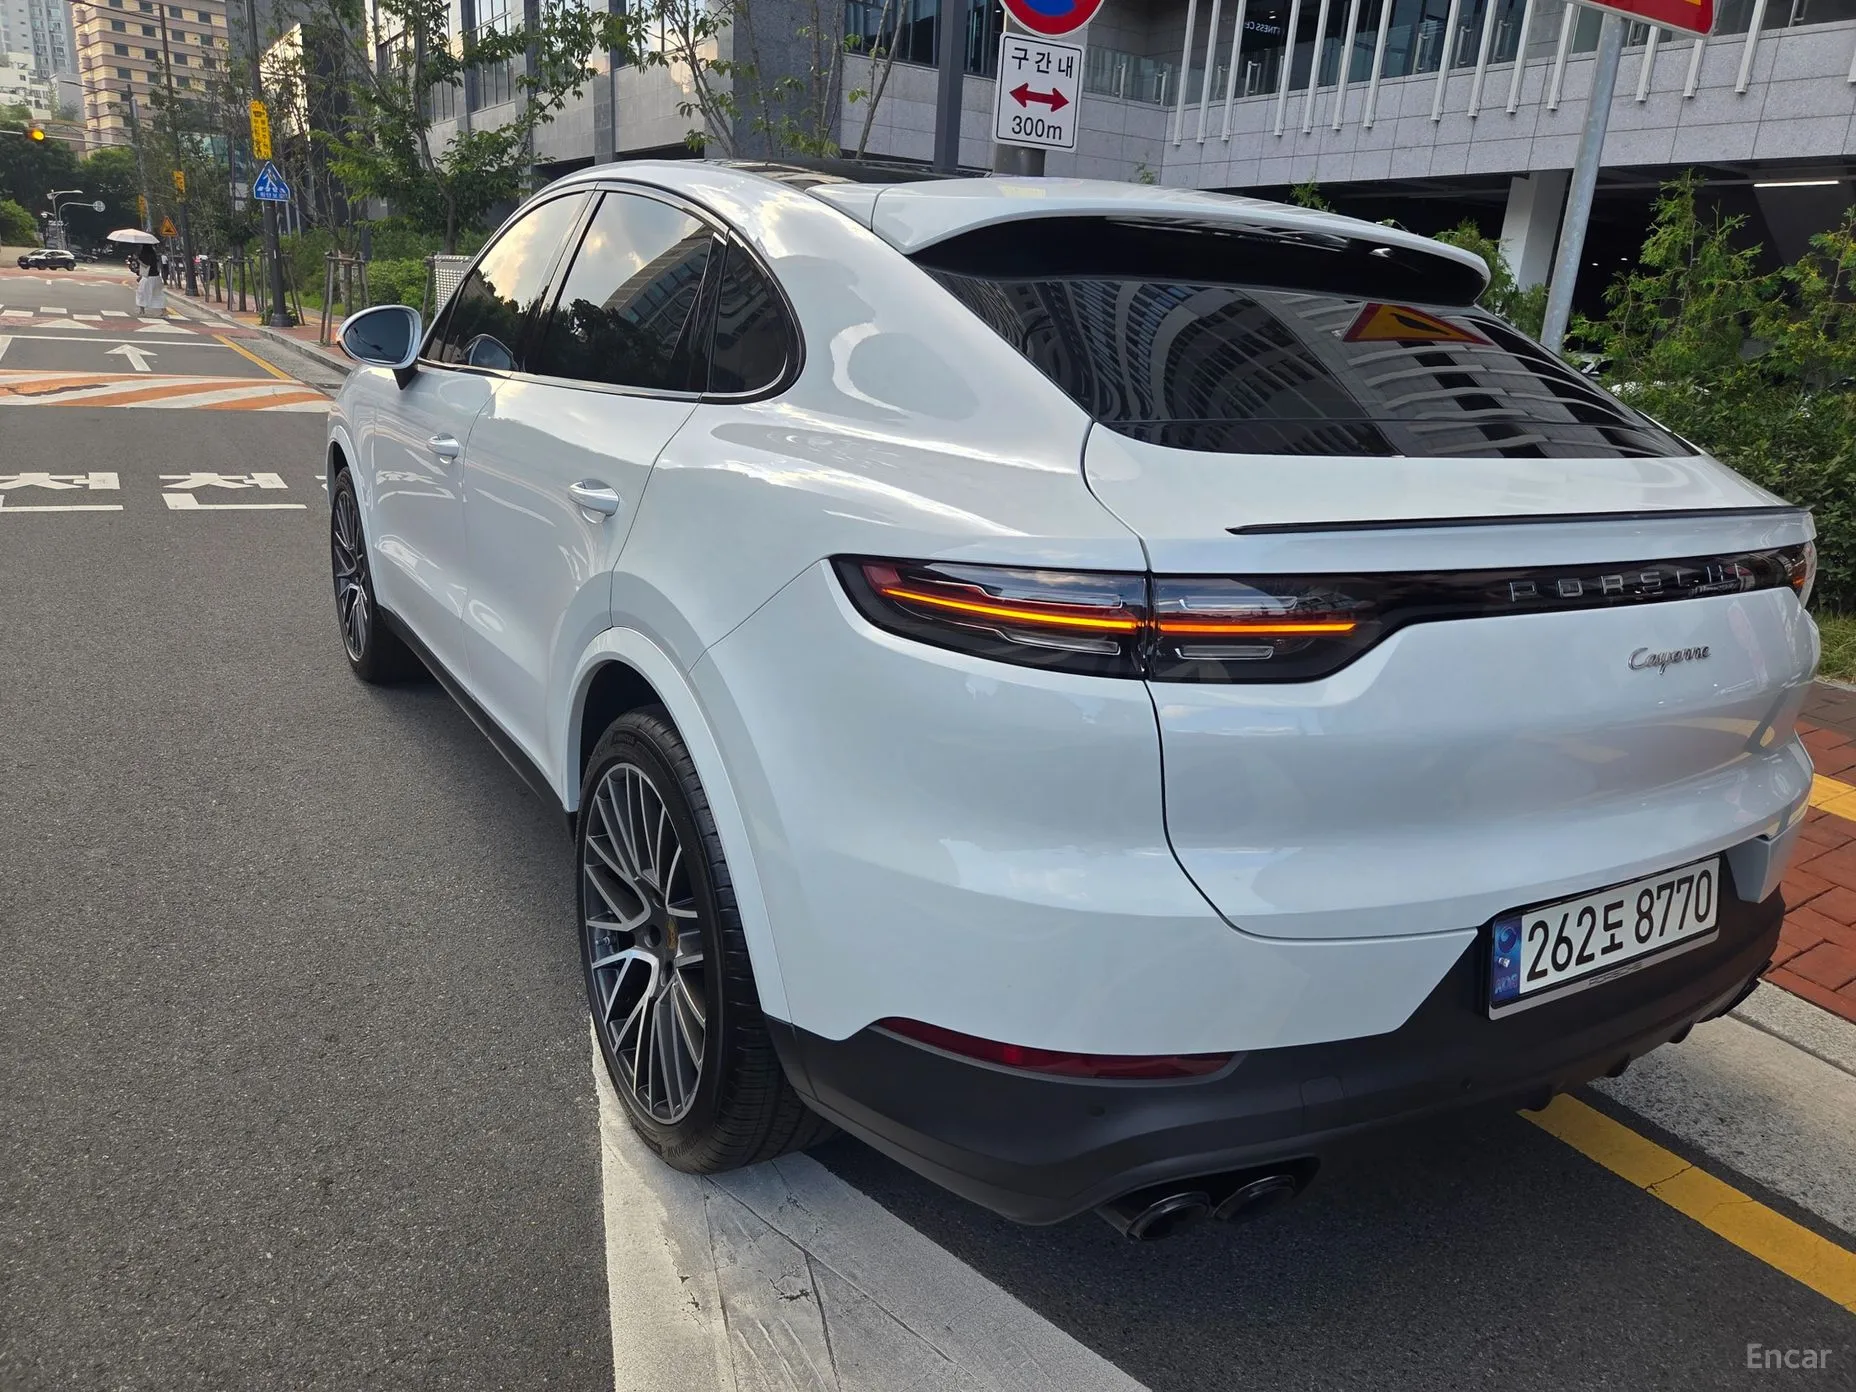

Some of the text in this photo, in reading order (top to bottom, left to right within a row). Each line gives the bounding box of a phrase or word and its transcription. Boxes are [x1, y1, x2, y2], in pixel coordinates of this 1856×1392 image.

[1012, 115, 1062, 140] 300m
[1627, 646, 1711, 676] Cayenne
[1526, 869, 1712, 982] 262도 8770
